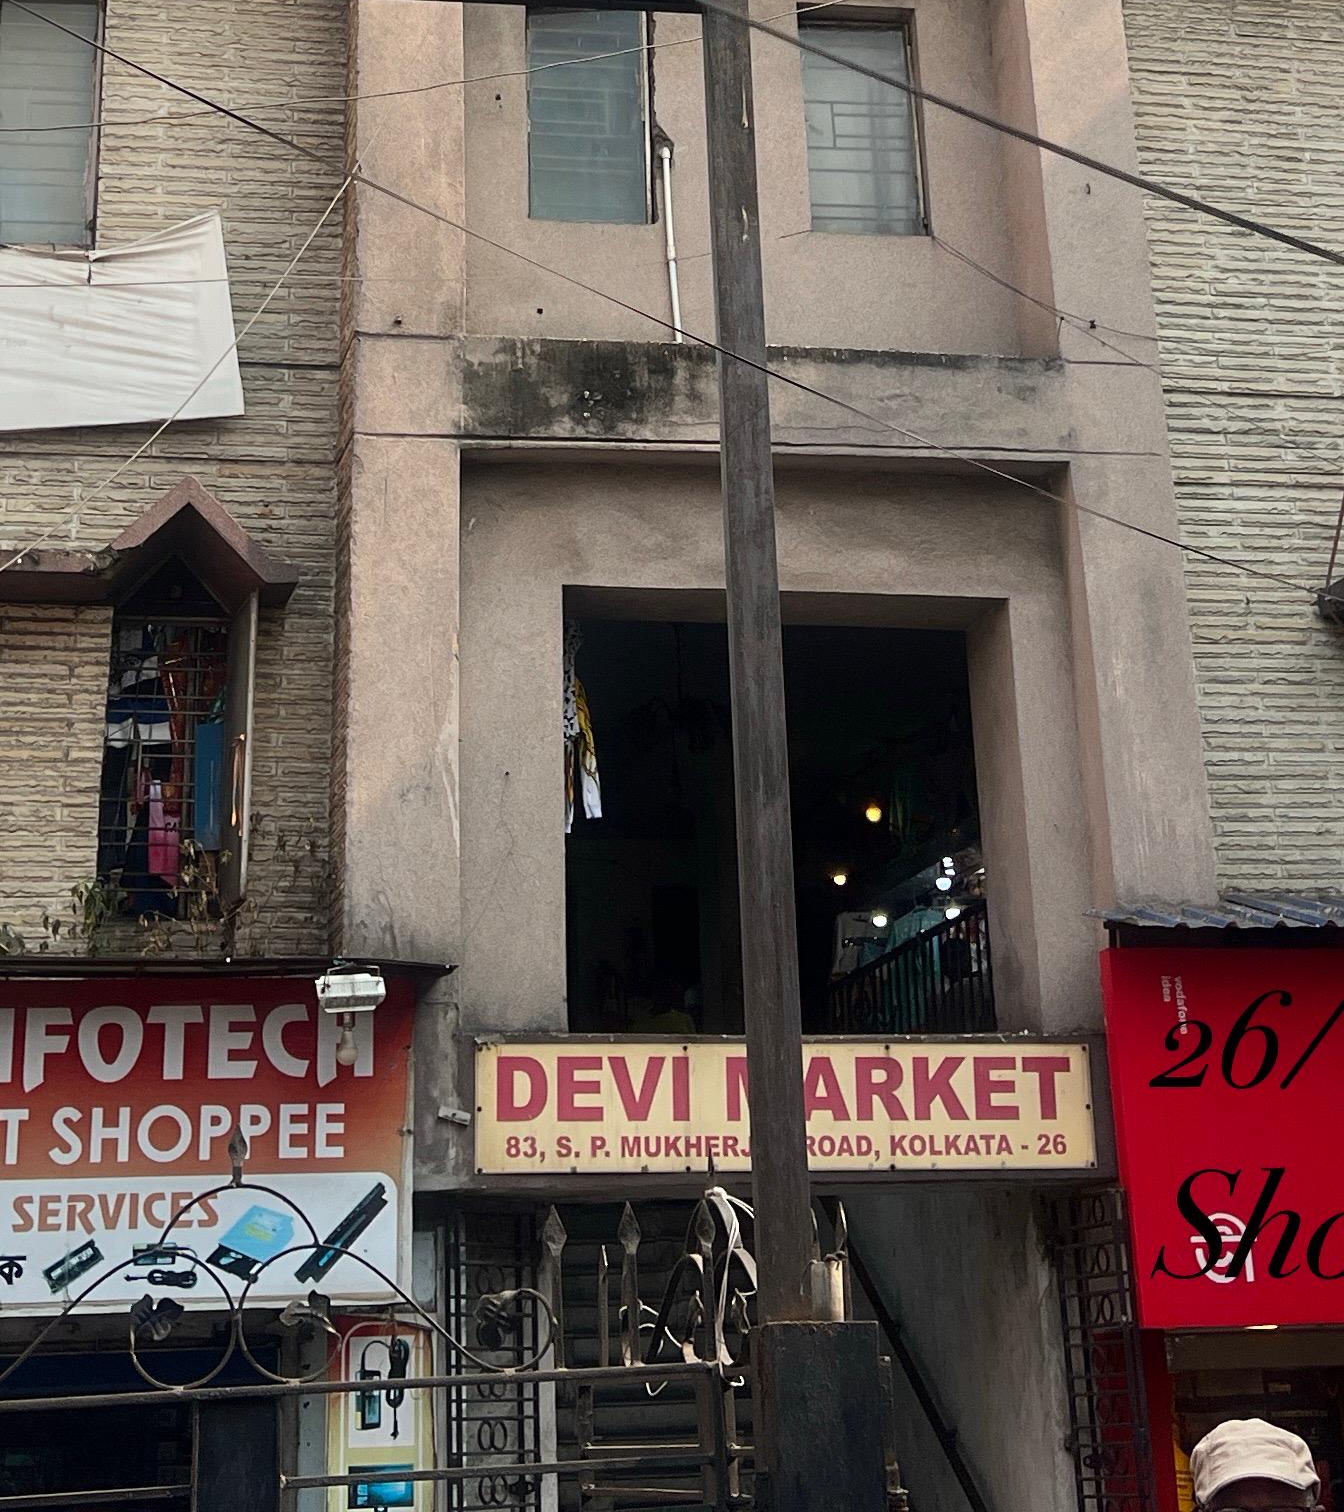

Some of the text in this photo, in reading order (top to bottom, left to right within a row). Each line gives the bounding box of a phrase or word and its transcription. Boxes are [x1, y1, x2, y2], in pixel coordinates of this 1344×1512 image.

[495, 1055, 691, 1123] DEVI
[48, 1102, 345, 1167] SHOPPEE
[506, 1135, 546, 1163] 83,
[555, 1135, 580, 1159] S.
[591, 1135, 610, 1158] P.
[890, 1133, 1014, 1157] KOLKATA
[1037, 1132, 1068, 1156] 26
[11, 1191, 219, 1236] SERVICES
